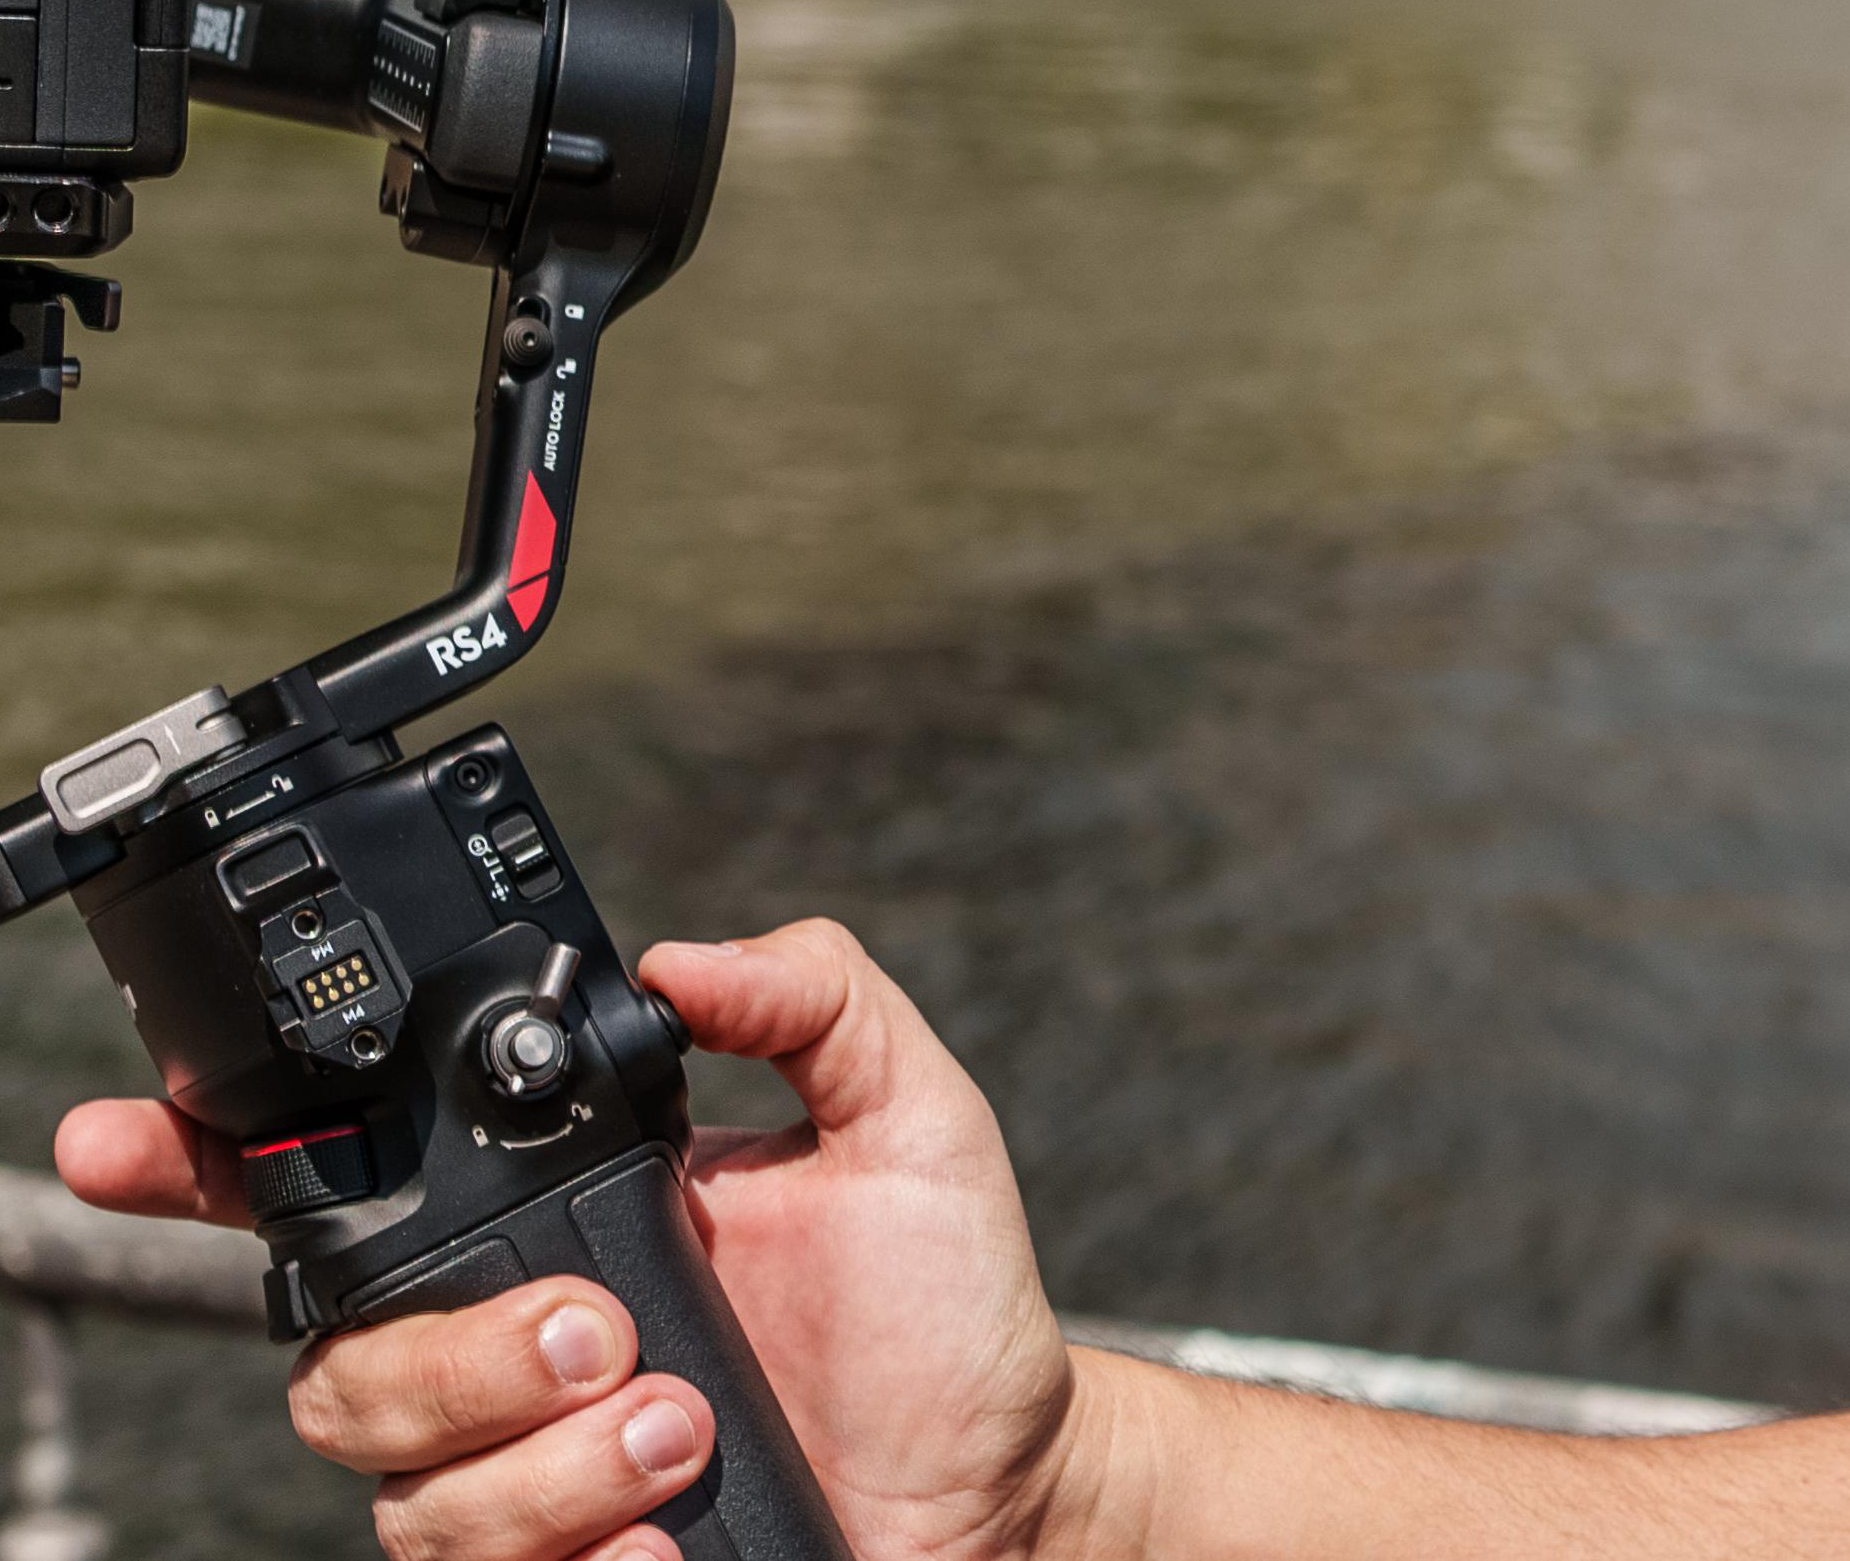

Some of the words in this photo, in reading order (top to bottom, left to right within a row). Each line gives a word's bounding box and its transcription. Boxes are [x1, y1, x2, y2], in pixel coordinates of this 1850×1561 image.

[548, 390, 566, 430] LOCK
[544, 431, 560, 472] AUTO
[426, 611, 508, 676] RS4
[311, 941, 335, 961] M4
[342, 1003, 366, 1025] M4
